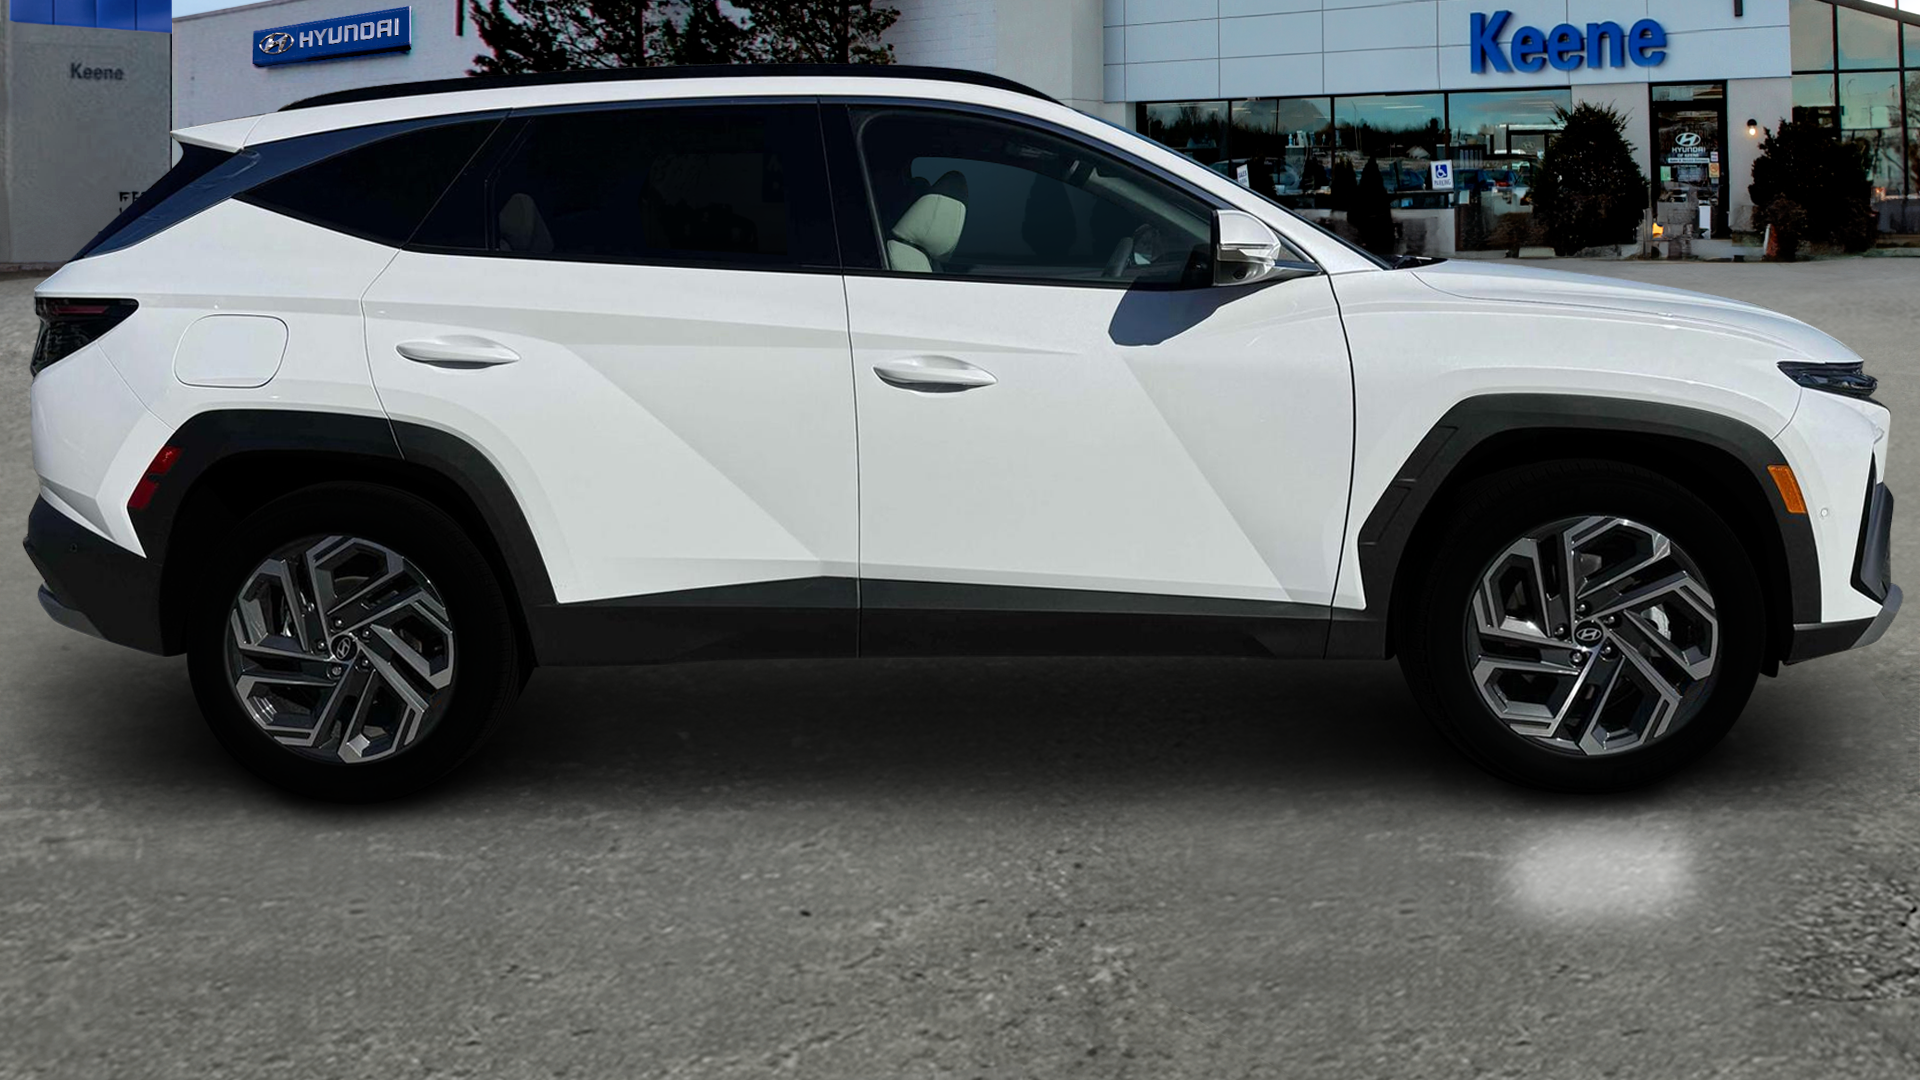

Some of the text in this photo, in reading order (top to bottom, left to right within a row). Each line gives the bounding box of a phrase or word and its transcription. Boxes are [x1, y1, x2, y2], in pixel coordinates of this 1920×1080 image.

[299, 17, 400, 49] HYUNDAI
[1470, 10, 1667, 74] Keene
[70, 62, 125, 80] Keene
